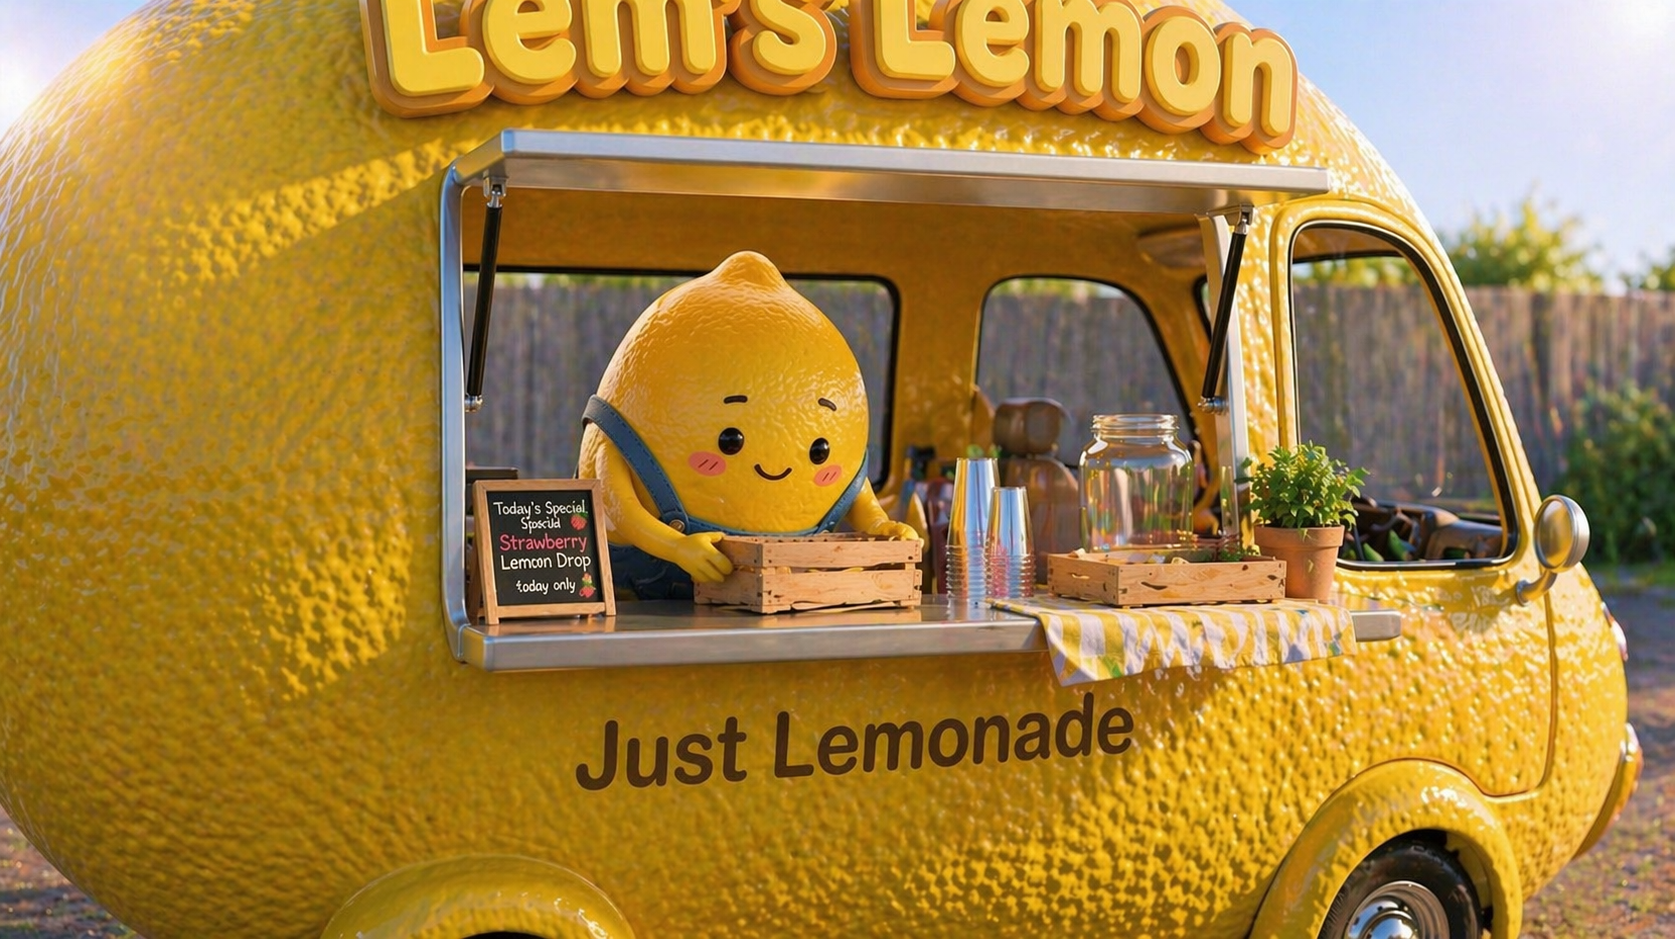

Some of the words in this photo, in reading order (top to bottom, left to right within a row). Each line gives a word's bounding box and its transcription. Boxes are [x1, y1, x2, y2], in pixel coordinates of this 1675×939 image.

[372, 0, 832, 106] Lems
[862, 0, 1295, 146] Lemon
[493, 501, 541, 519] Today's
[500, 533, 588, 553] Strawberry
[556, 552, 591, 572] Drop
[553, 577, 576, 593] only
[575, 715, 748, 791] Just
[773, 691, 1135, 779] Lemonade
